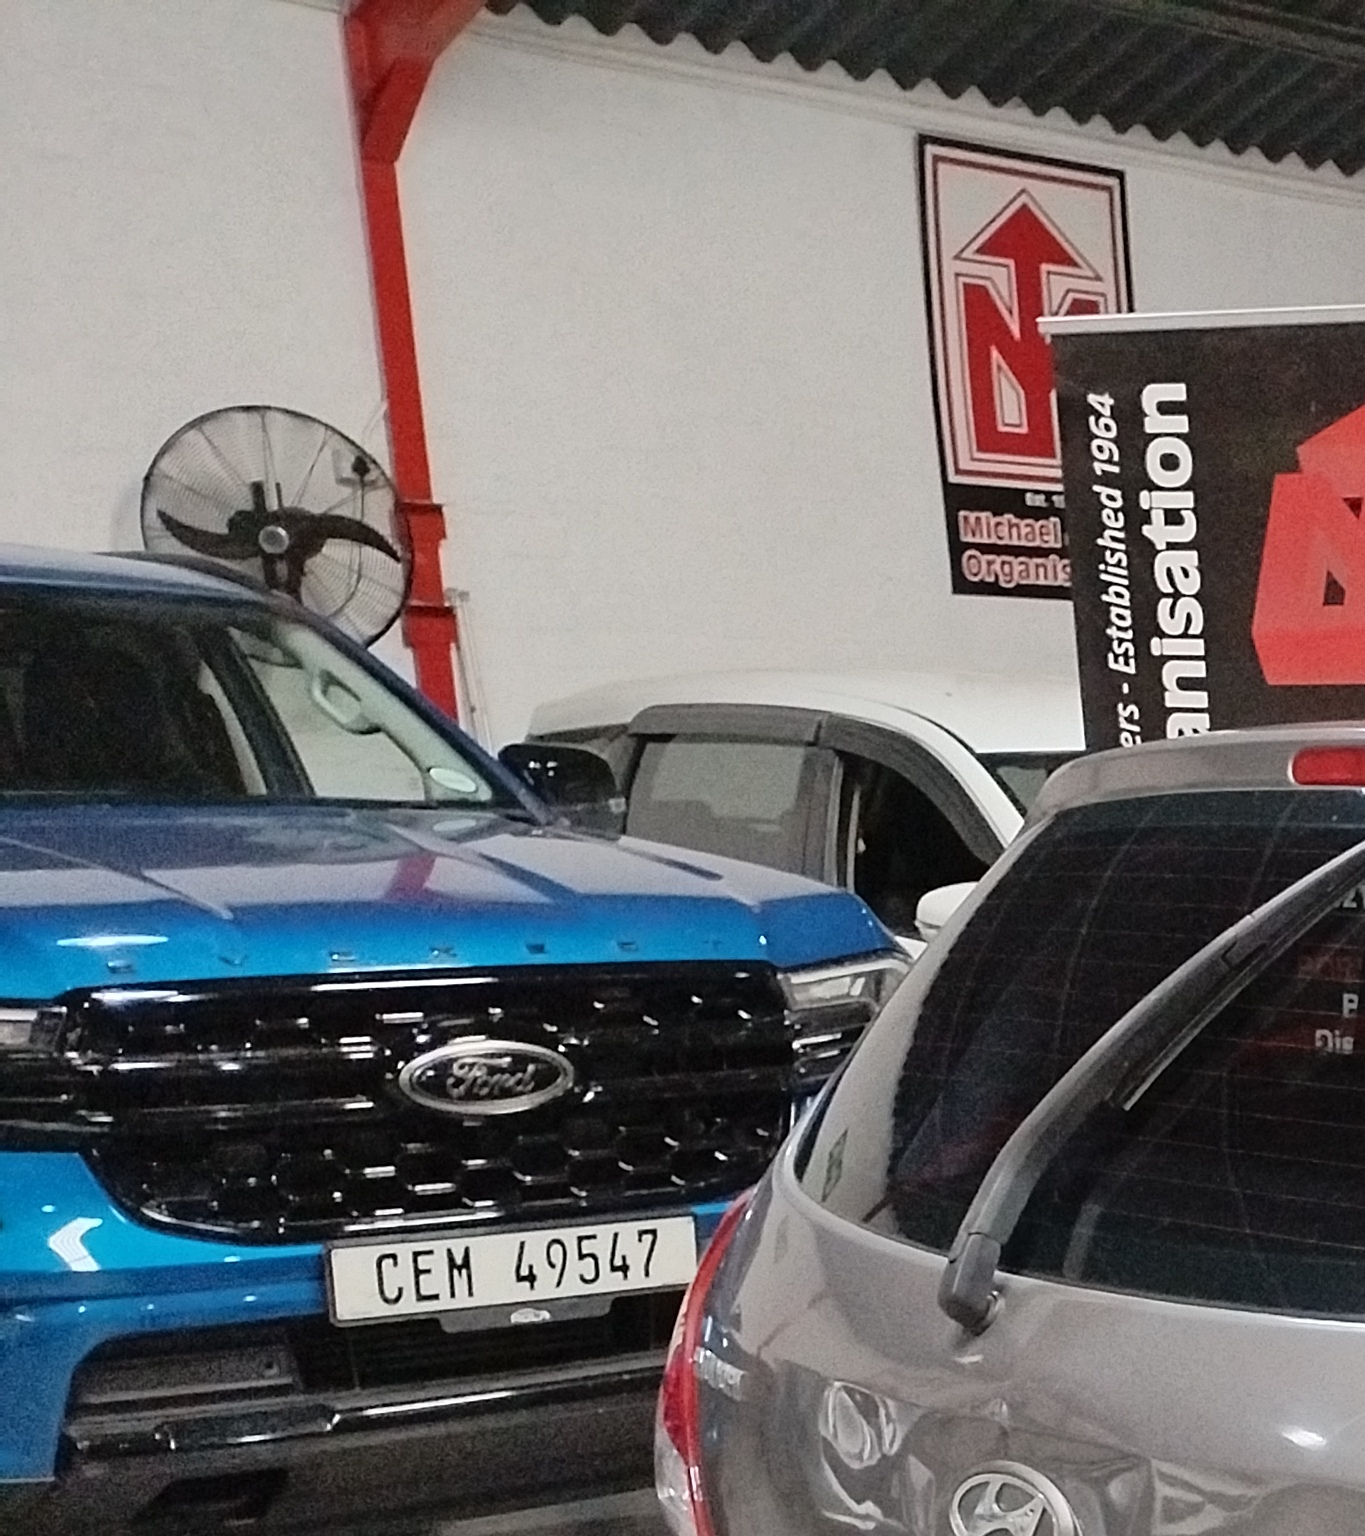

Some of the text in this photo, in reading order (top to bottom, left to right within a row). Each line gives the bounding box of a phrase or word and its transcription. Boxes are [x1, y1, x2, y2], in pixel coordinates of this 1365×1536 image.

[1087, 392, 1120, 476] 1964
[958, 510, 1062, 549] Michael
[1092, 484, 1136, 675] Established
[446, 1056, 535, 1098] Ford
[374, 1228, 660, 1305] CEM 49547
